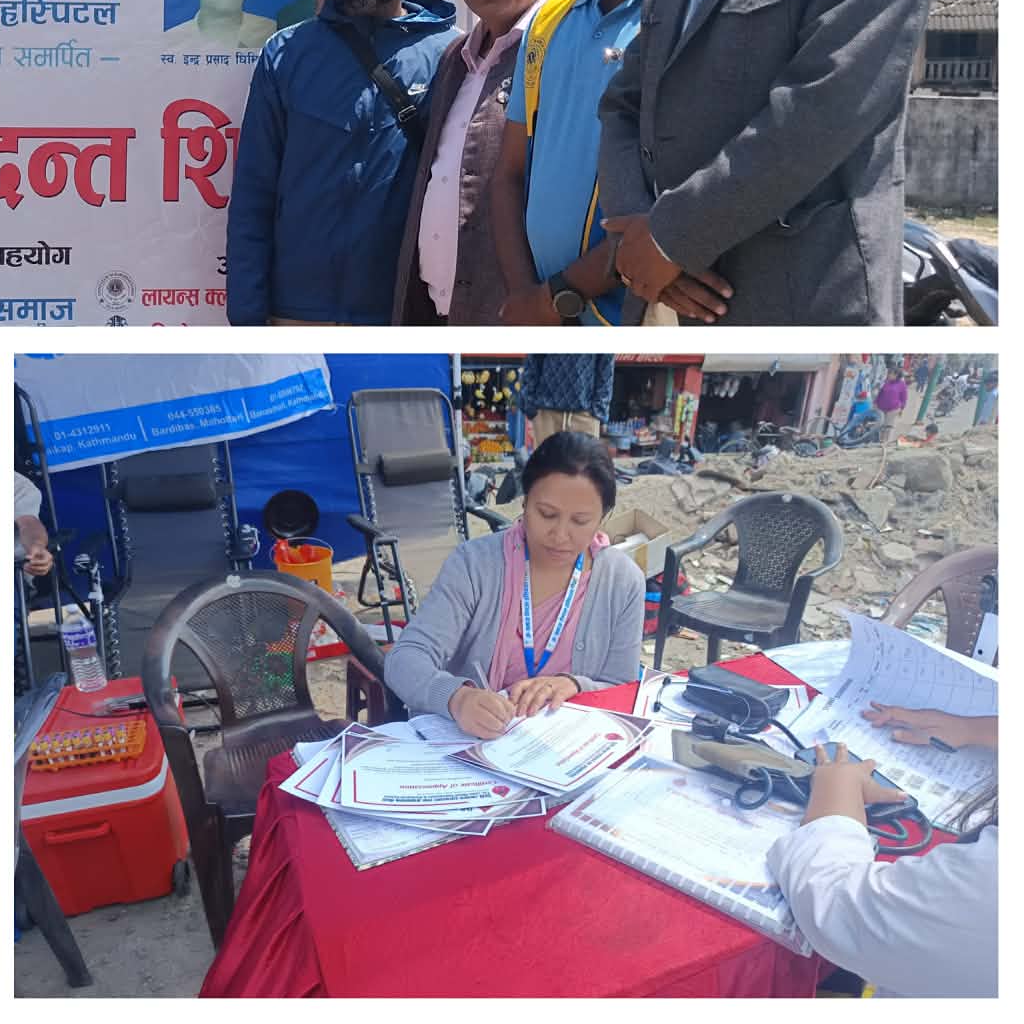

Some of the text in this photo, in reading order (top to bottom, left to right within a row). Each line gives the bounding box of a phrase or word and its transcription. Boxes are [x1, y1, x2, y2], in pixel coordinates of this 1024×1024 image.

[14, 37, 93, 68] समर्पित
[141, 288, 200, 307] लायन्स
[54, 422, 112, 441] 01-4312911
[77, 432, 137, 450] Kathmandu
